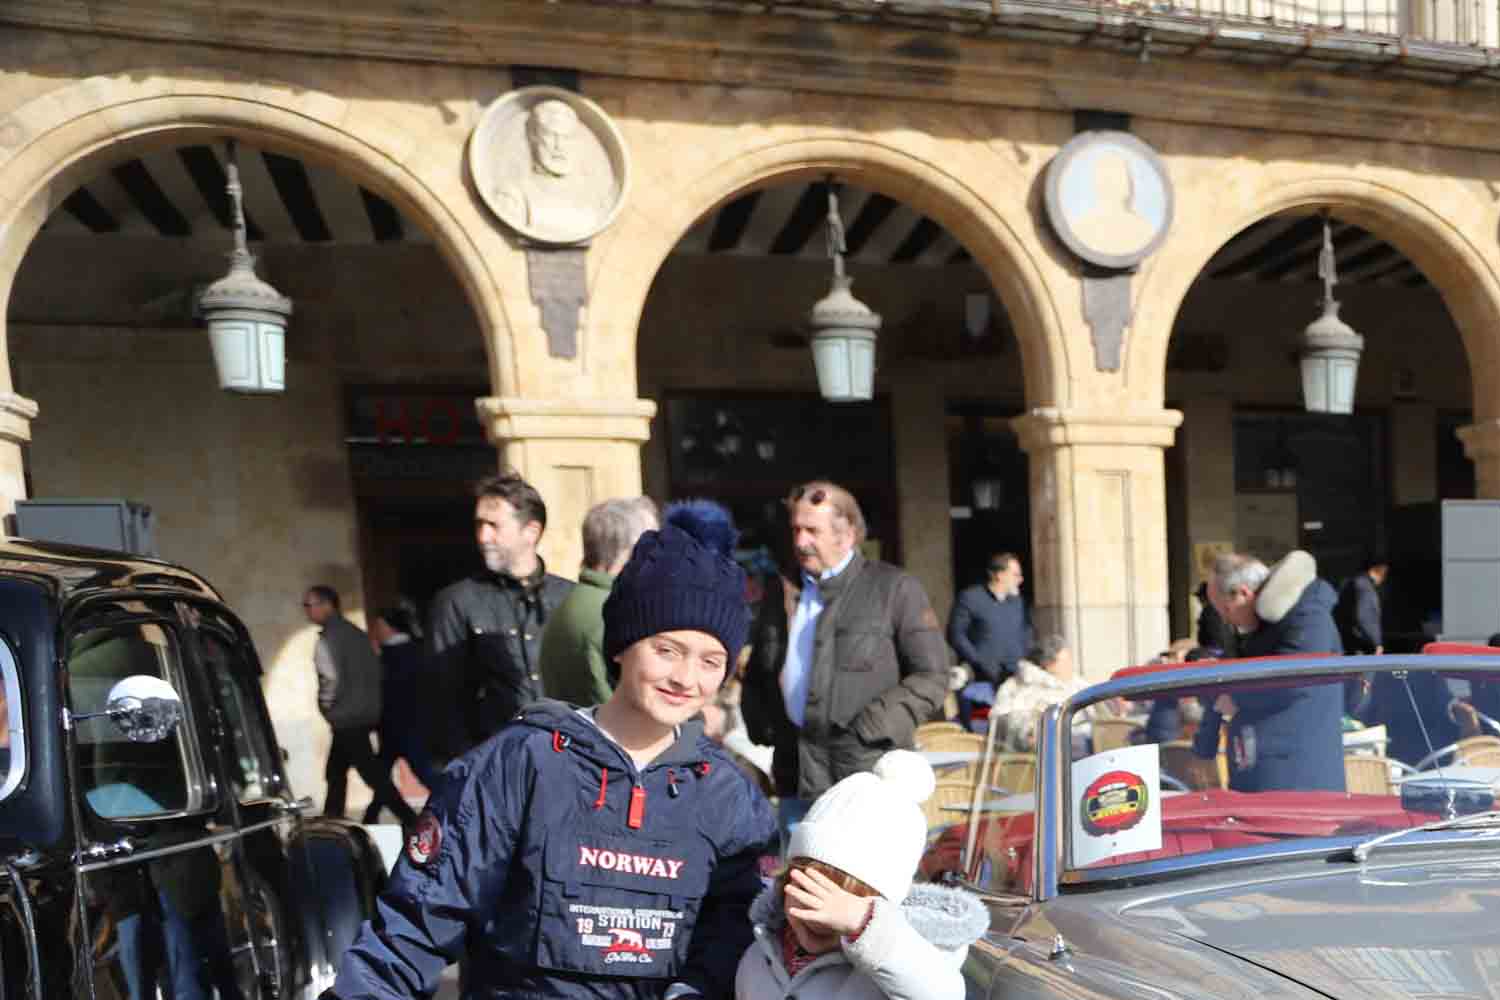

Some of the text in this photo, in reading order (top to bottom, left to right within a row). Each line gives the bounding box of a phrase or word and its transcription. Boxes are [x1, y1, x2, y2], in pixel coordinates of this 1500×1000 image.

[376, 400, 488, 447] HO
[578, 846, 684, 880] NORWAY
[576, 917, 594, 934] 19
[598, 913, 662, 930] STATION
